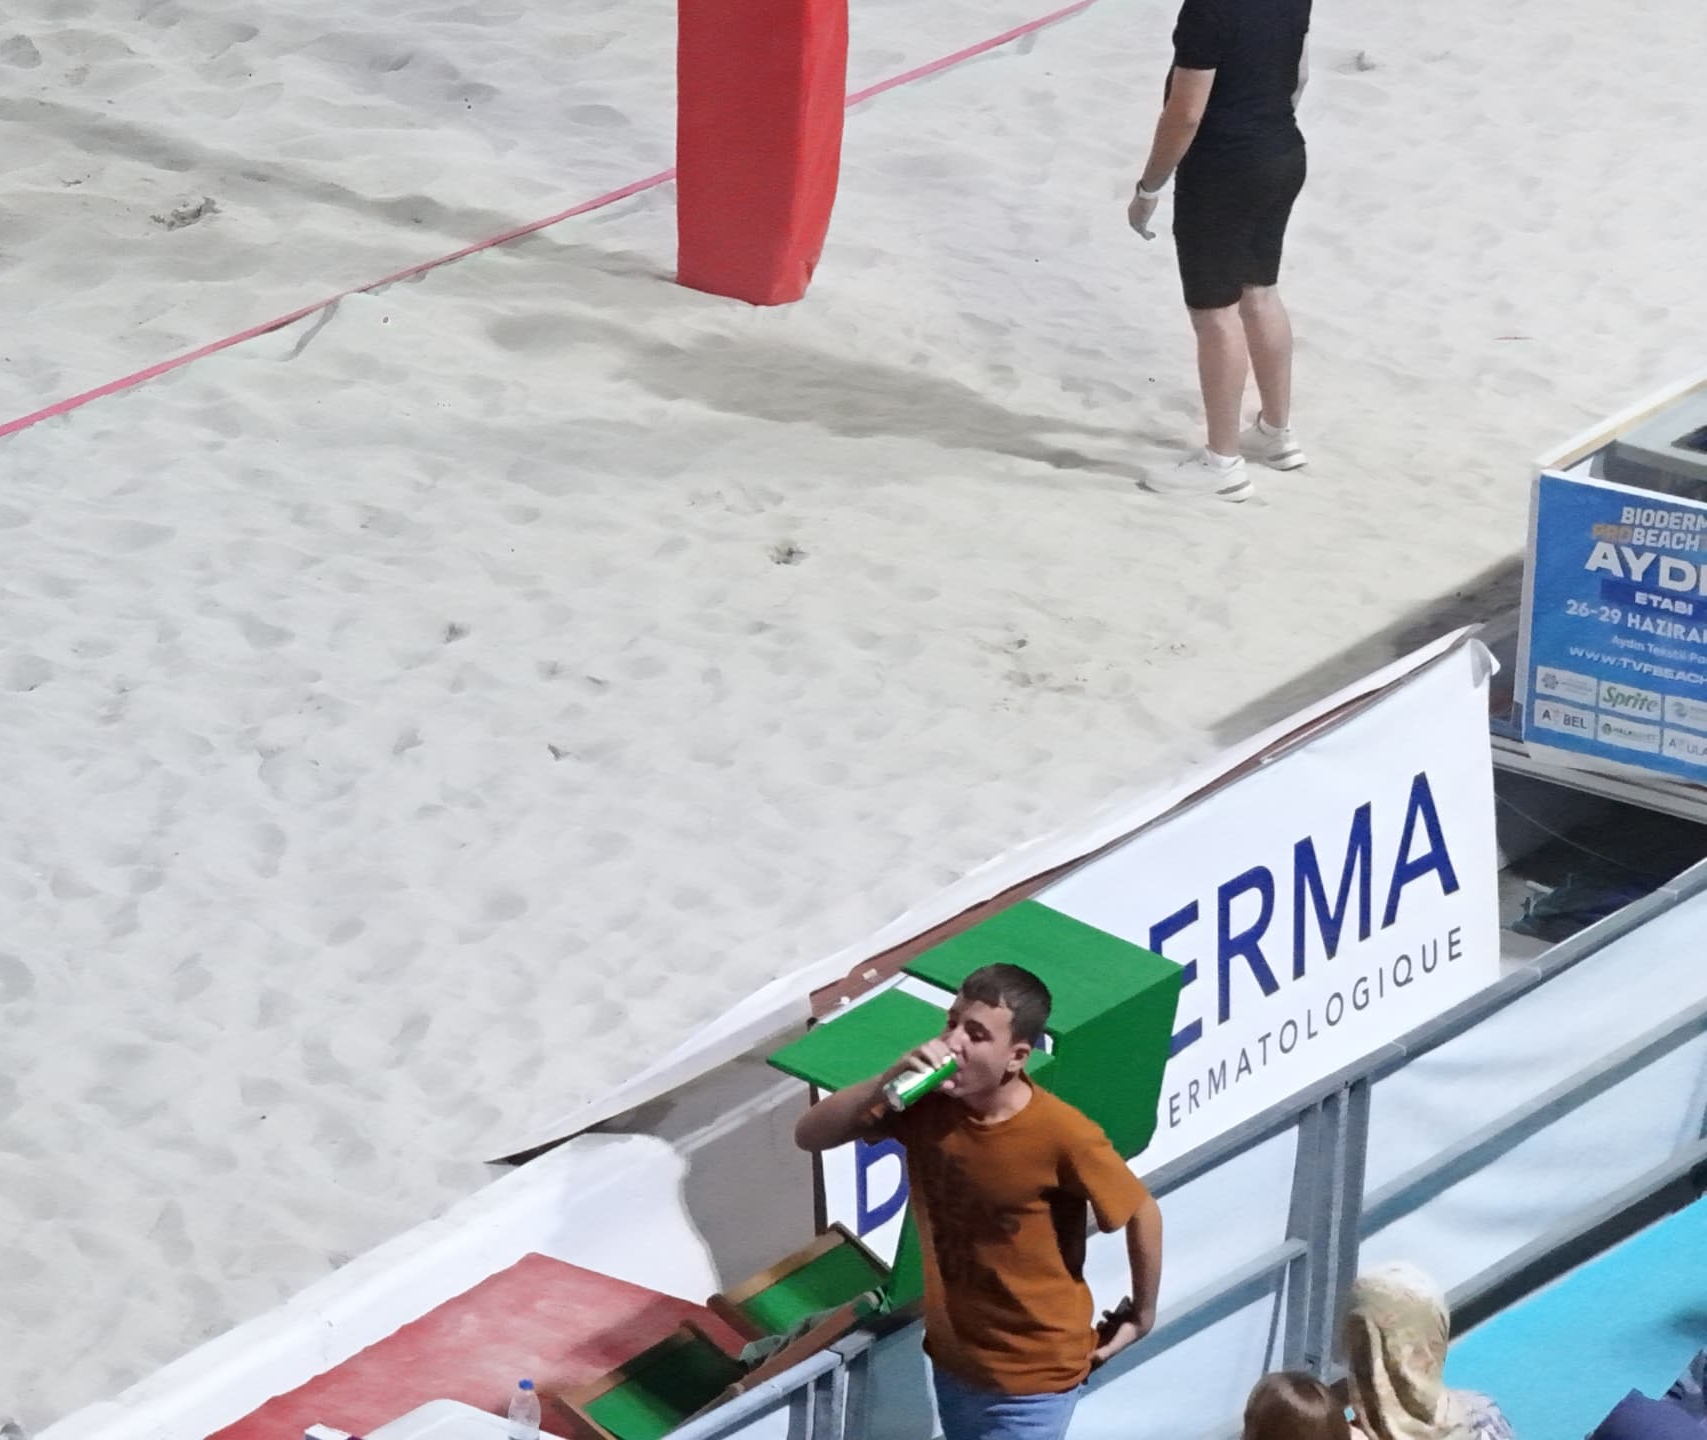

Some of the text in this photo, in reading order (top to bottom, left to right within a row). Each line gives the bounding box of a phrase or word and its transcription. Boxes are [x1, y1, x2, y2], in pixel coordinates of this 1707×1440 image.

[1566, 599, 1621, 625] 26-29
[1635, 591, 1693, 616] ETABI
[1603, 686, 1658, 714] Sprite
[1169, 926, 1462, 1129] ERMATOLOGIQUE
